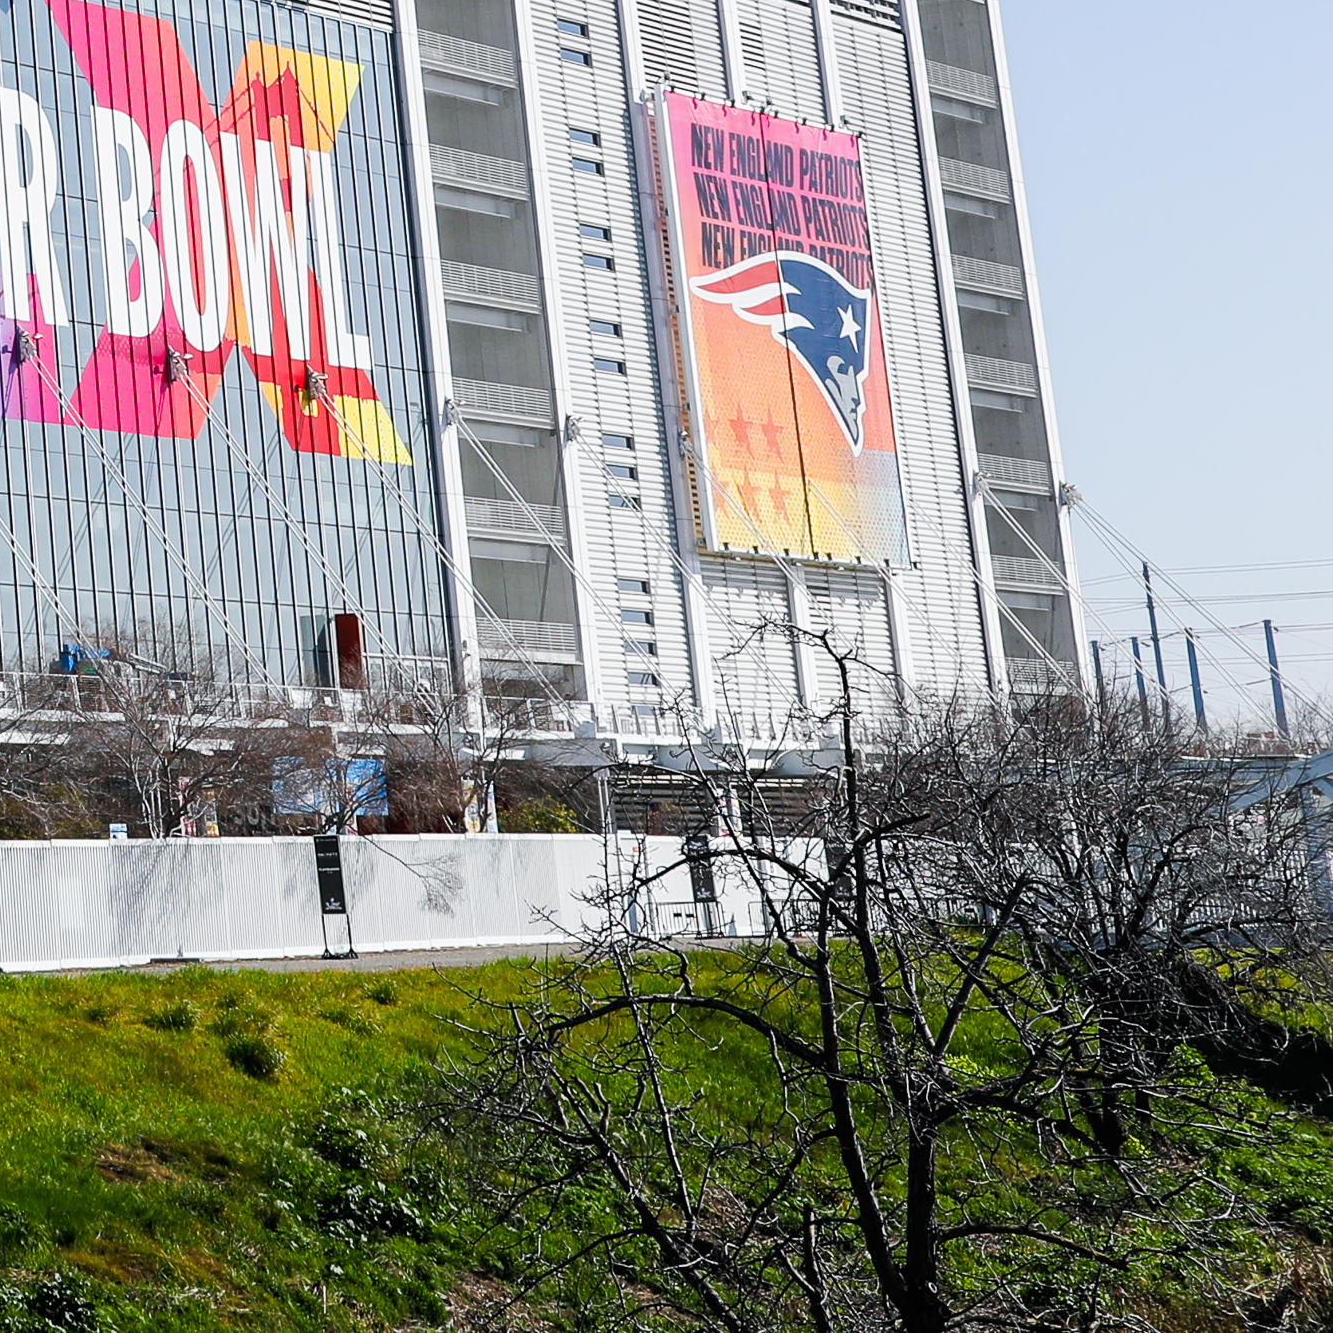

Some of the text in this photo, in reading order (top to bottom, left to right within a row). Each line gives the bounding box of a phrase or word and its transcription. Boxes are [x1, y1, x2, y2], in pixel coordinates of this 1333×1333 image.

[691, 122, 865, 203] NEW ENGLAND PATRIOTS
[90, 104, 372, 371] BOWL
[693, 171, 732, 223] NEW
[732, 180, 802, 236] ENGLAND
[801, 194, 870, 251] PATRIOTS
[701, 221, 735, 270] NEW
